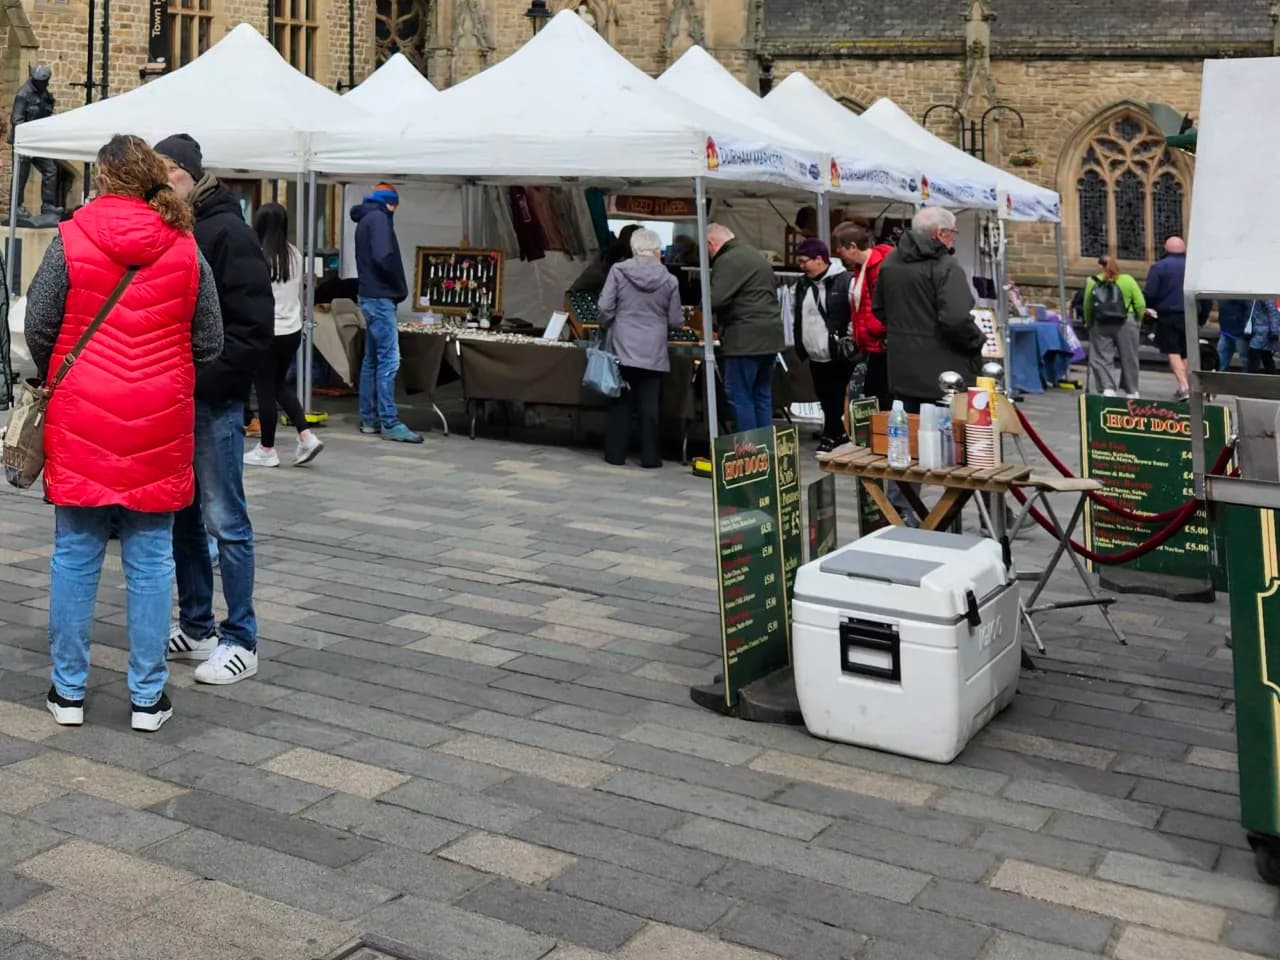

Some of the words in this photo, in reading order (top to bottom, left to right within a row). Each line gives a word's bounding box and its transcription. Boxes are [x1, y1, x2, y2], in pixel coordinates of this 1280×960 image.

[152, 8, 161, 38] Town
[1127, 399, 1180, 419] Fusion
[1106, 413, 1147, 431] HOT
[1150, 417, 1193, 435] DOG
[724, 459, 745, 480] HOT
[745, 453, 769, 476] DOGS
[1184, 526, 1209, 536] £5.00
[1185, 542, 1210, 553] £5.00
